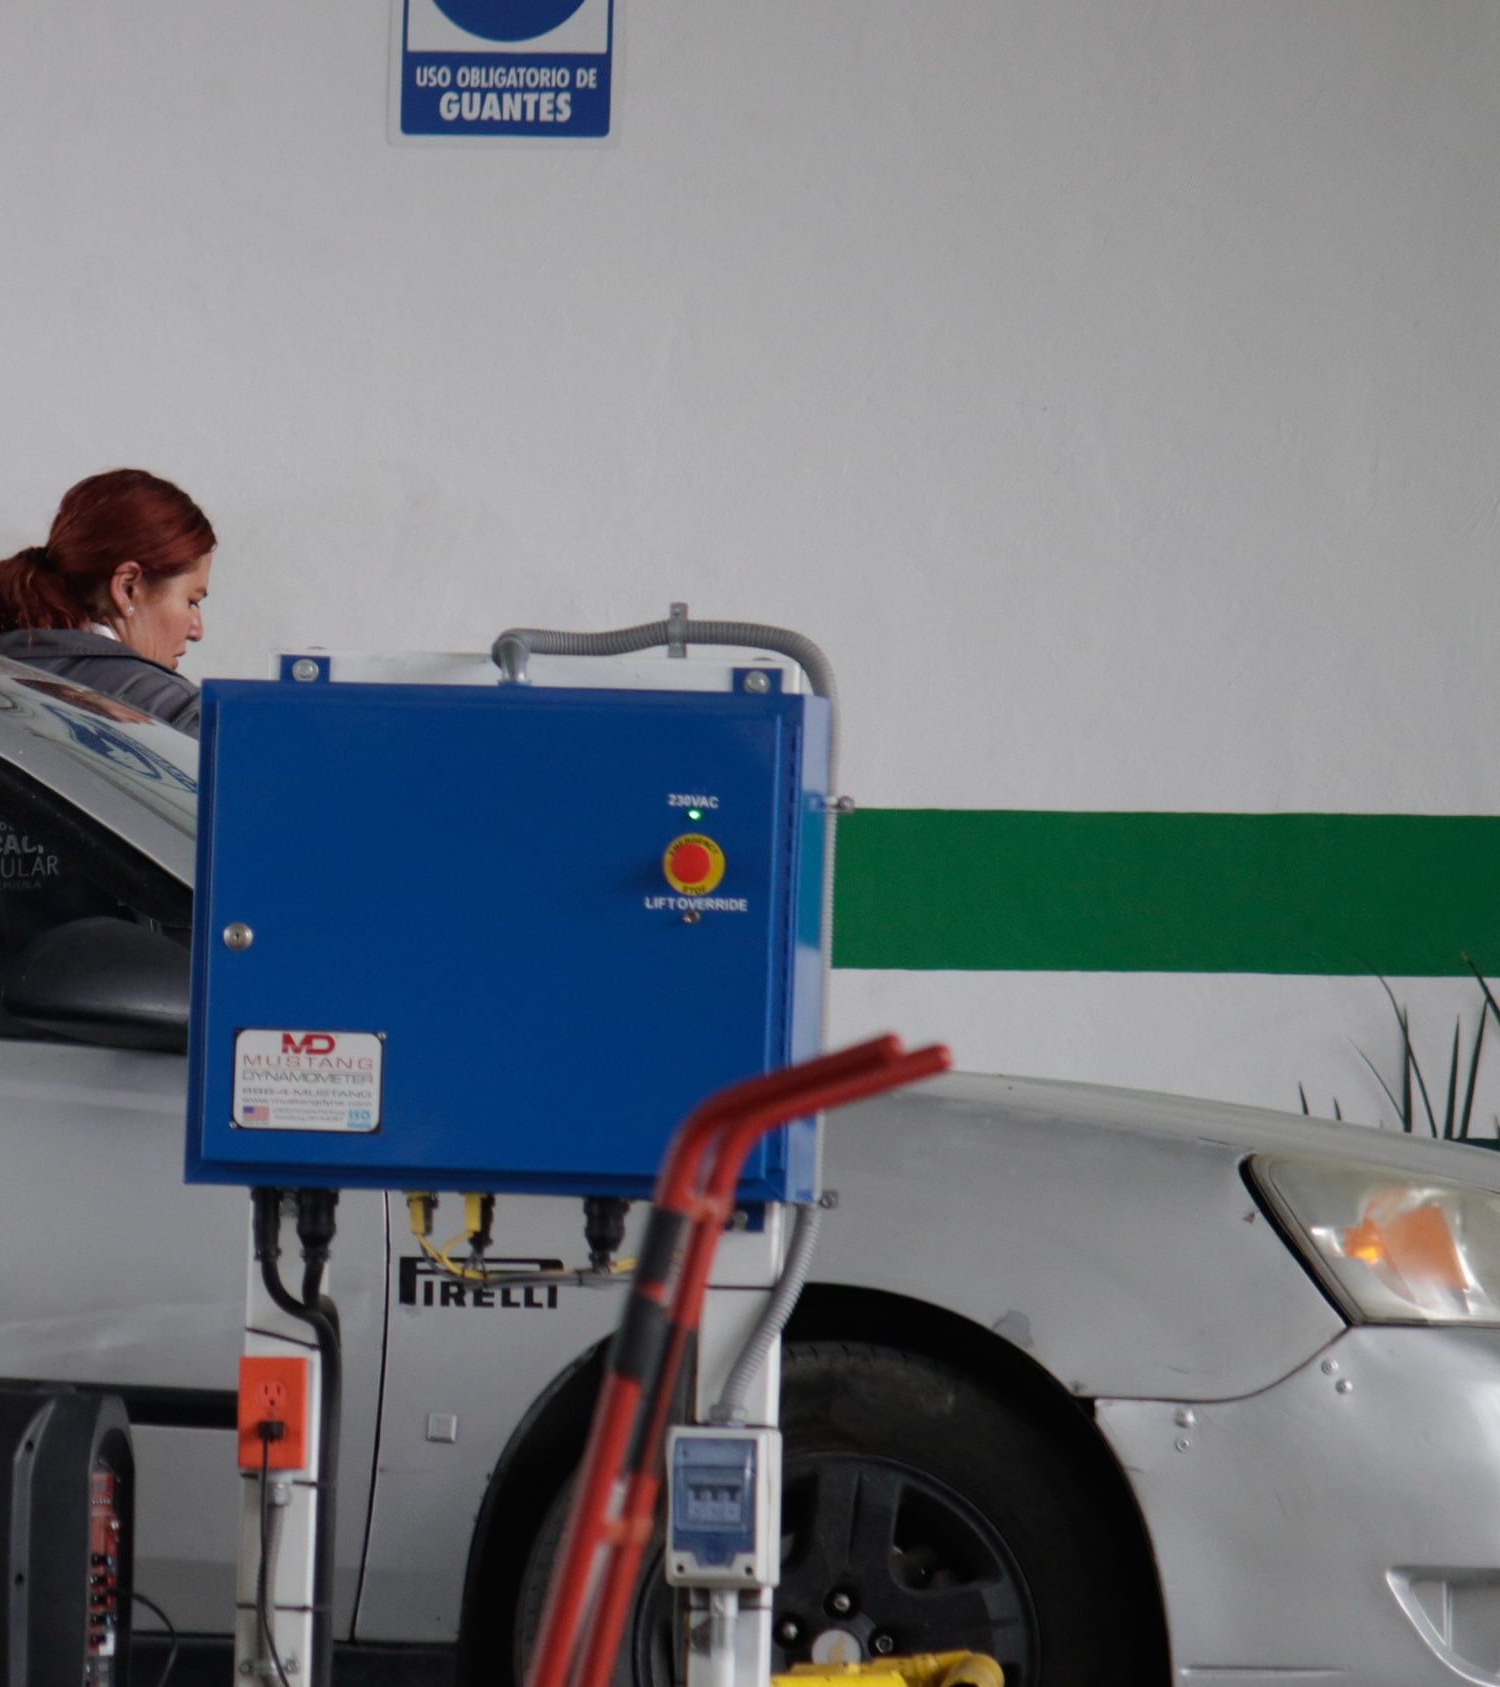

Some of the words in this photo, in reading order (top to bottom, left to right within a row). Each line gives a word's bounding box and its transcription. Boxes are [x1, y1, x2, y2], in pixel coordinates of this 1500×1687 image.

[416, 66, 450, 87] USO
[457, 67, 570, 88] OBLIGATORIO
[576, 69, 597, 89] DE
[440, 91, 572, 122] GUANTES
[668, 794, 719, 809] 230VAC
[645, 896, 676, 909] LIFT
[677, 898, 748, 911] OVERRIDE
[282, 1032, 336, 1055] MD
[243, 1054, 374, 1070] MUSTANG
[242, 1070, 373, 1085] DYNAMOMETER
[399, 1256, 564, 1309] PIRELLI
